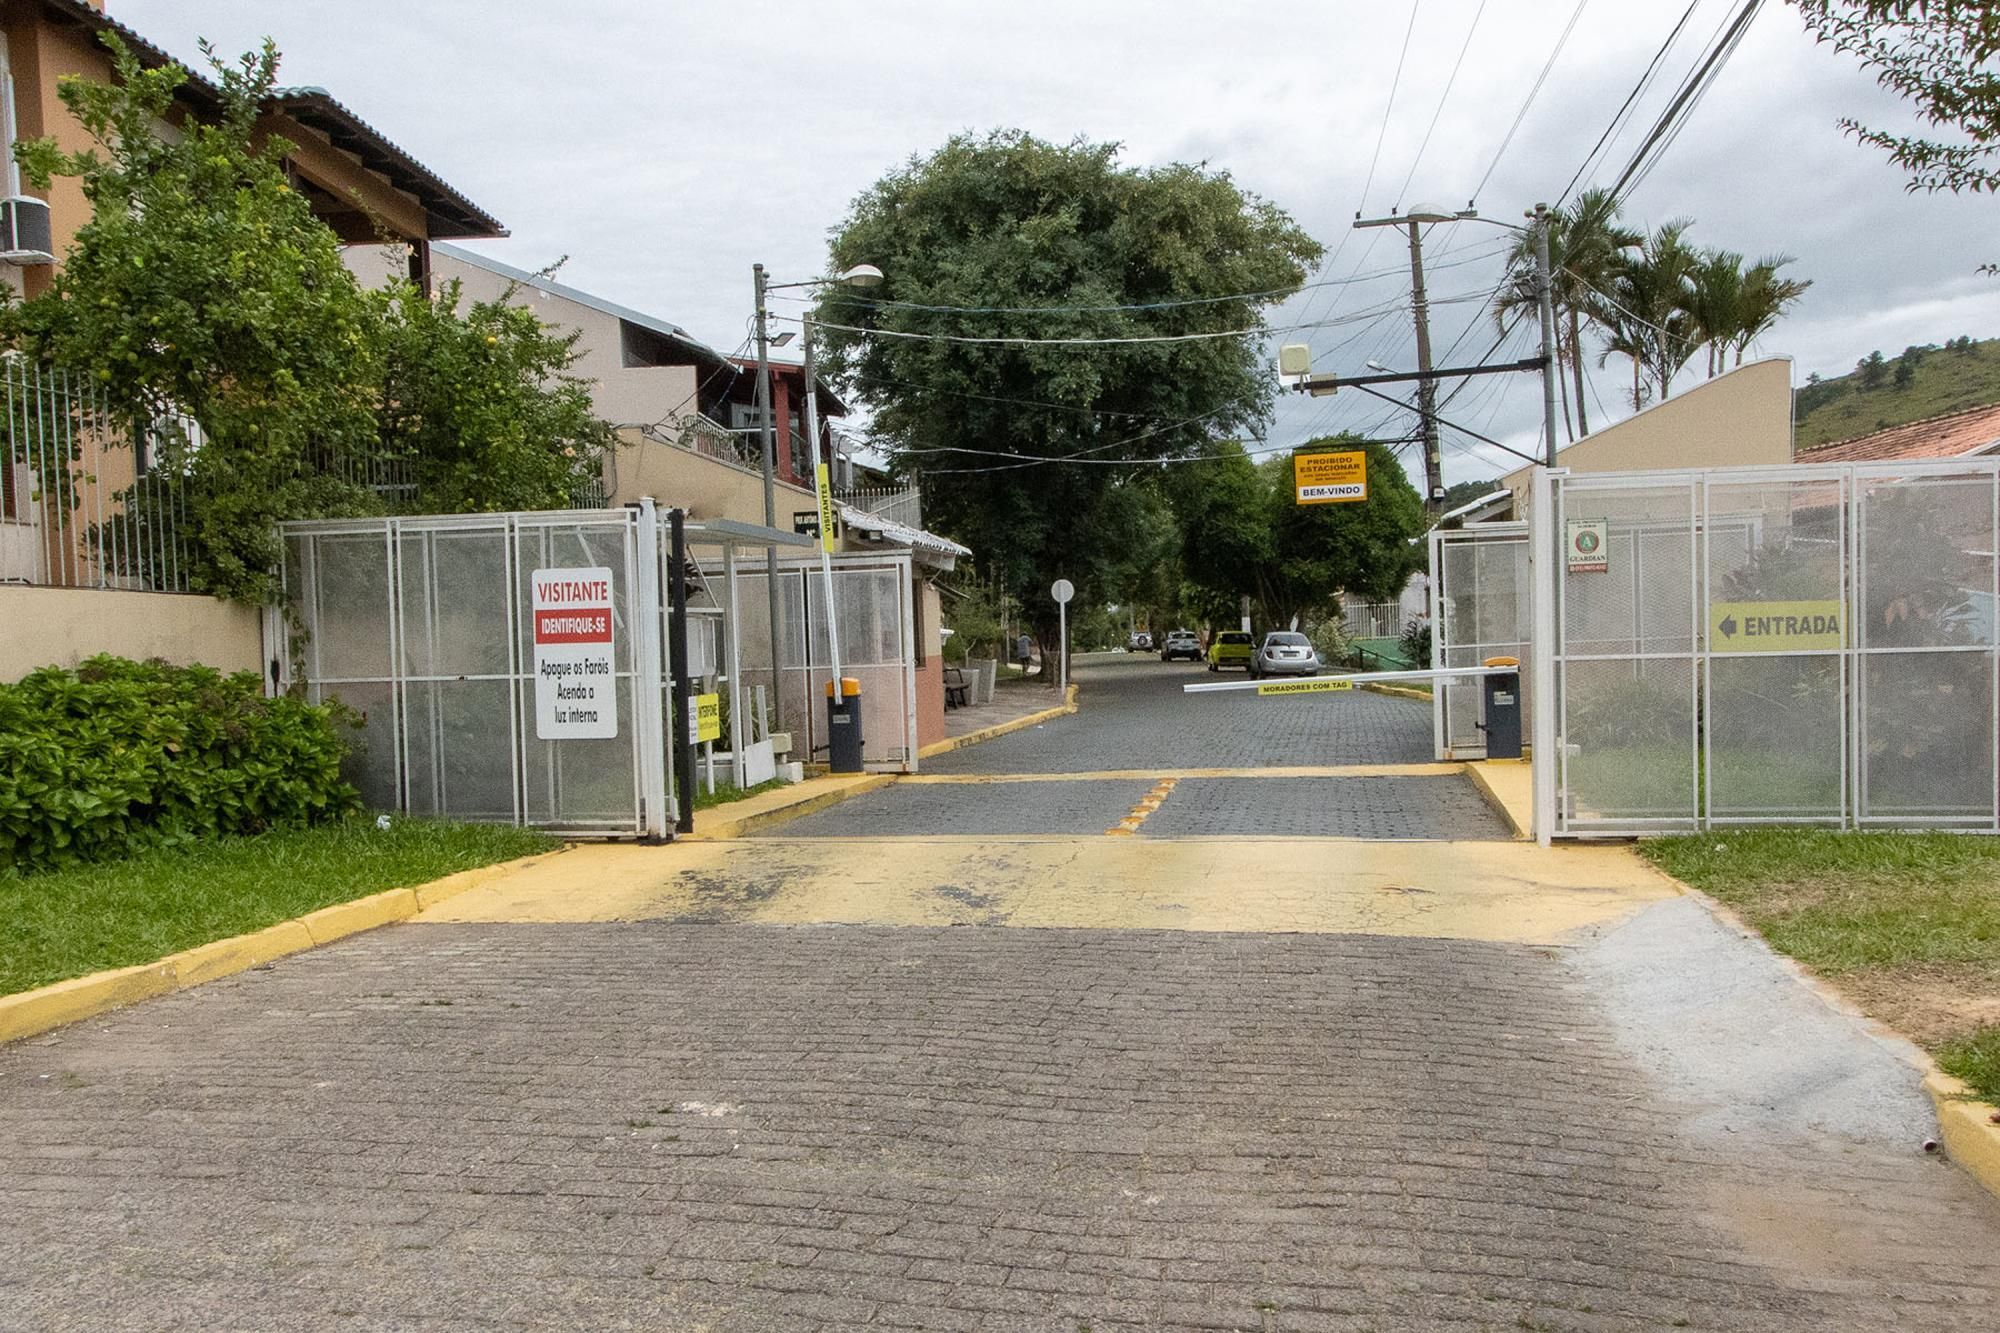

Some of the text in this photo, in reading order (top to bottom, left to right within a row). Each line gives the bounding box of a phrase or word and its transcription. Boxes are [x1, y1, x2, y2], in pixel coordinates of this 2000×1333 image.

[1300, 463, 1360, 473] ESTACIONAR
[1307, 457, 1353, 465] PROIBIDO
[1303, 486, 1360, 497] BEM-VINDO
[821, 483, 831, 532] VISITANTES
[538, 581, 608, 602] VISITANTE
[541, 617, 606, 635] IDENTIFIQUE-SE
[1744, 615, 1840, 636] ENTRADA
[541, 658, 609, 680] Apague os Faróis
[557, 683, 595, 700] Acenda a
[1263, 681, 1348, 692] MORADORES COM TAG
[554, 706, 598, 723] luz interna
